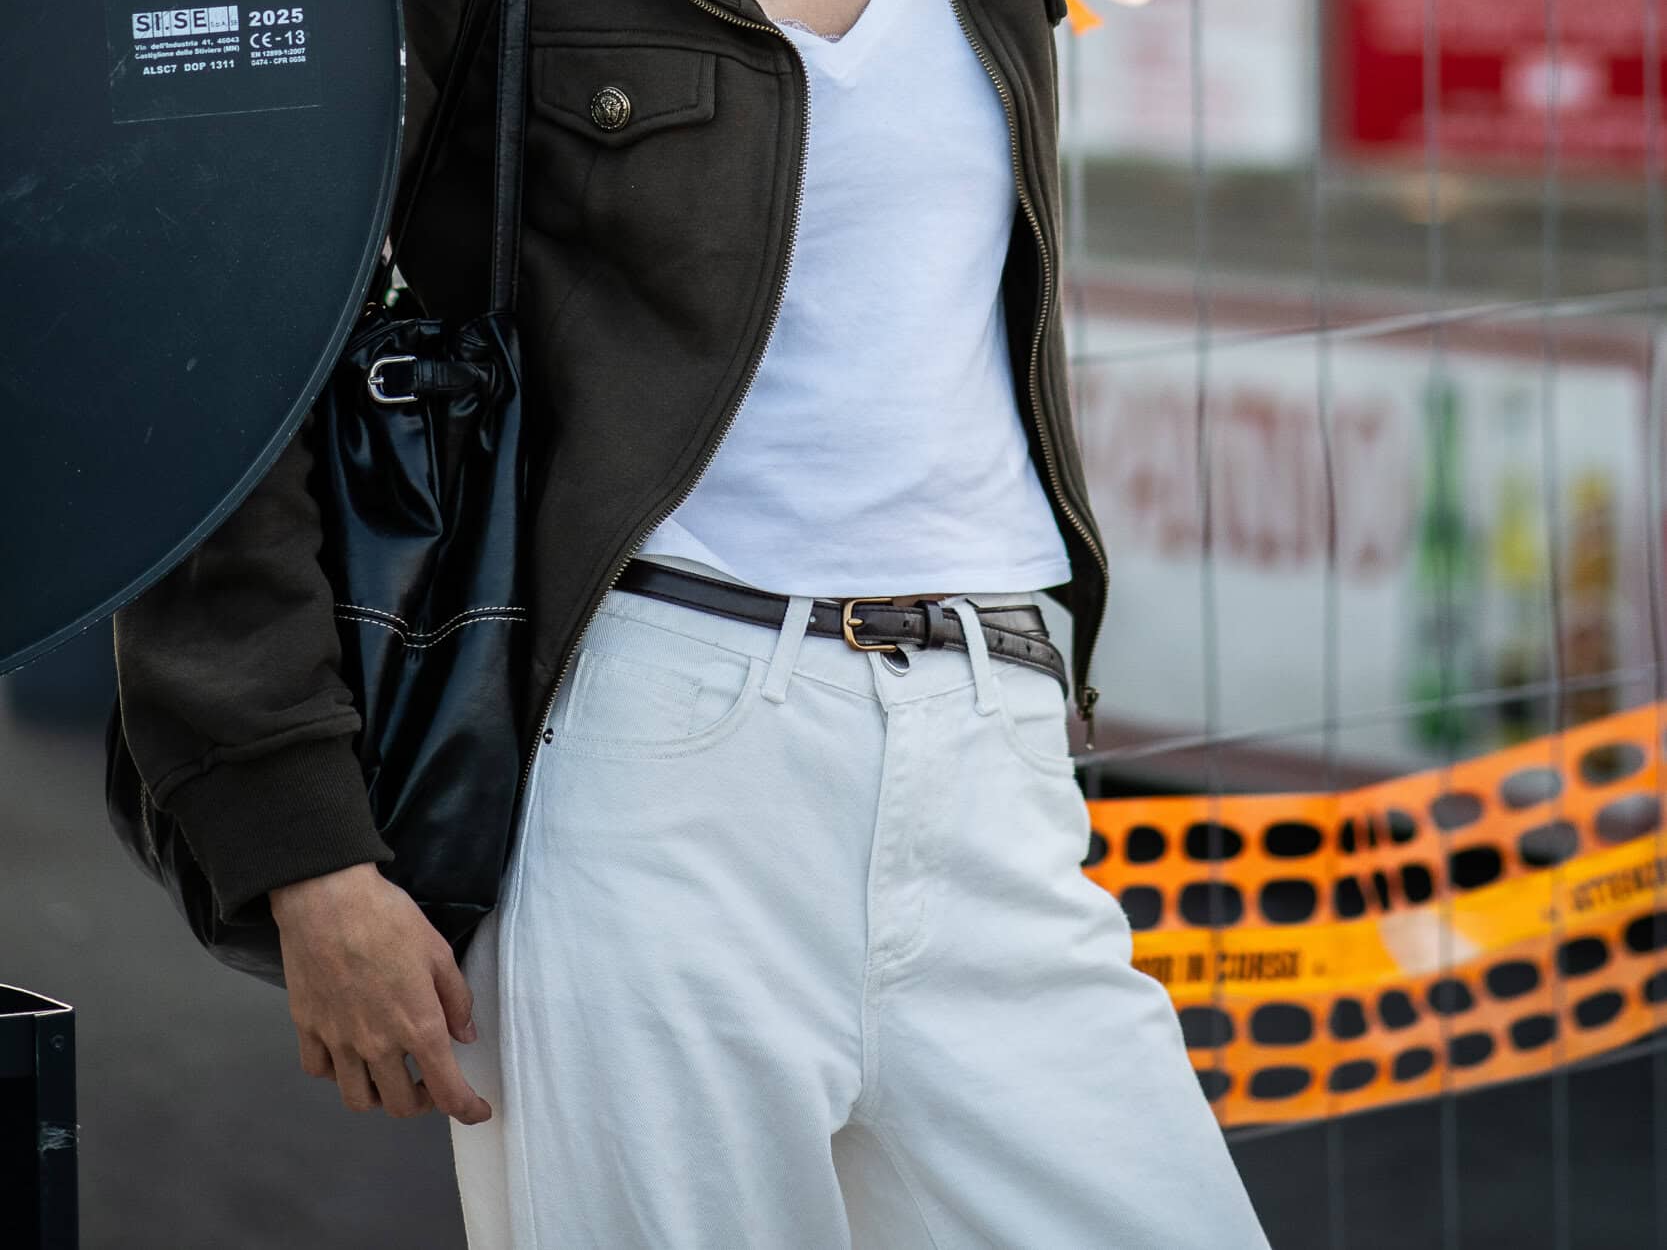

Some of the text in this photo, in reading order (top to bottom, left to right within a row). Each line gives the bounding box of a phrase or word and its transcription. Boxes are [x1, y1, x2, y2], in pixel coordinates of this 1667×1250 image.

[135, 10, 207, 32] SI.SE
[248, 8, 304, 27] 2025
[134, 51, 174, 60] Castiglione
[223, 45, 240, 53] (MN)
[143, 59, 235, 75] ALSC7 DOP 1311
